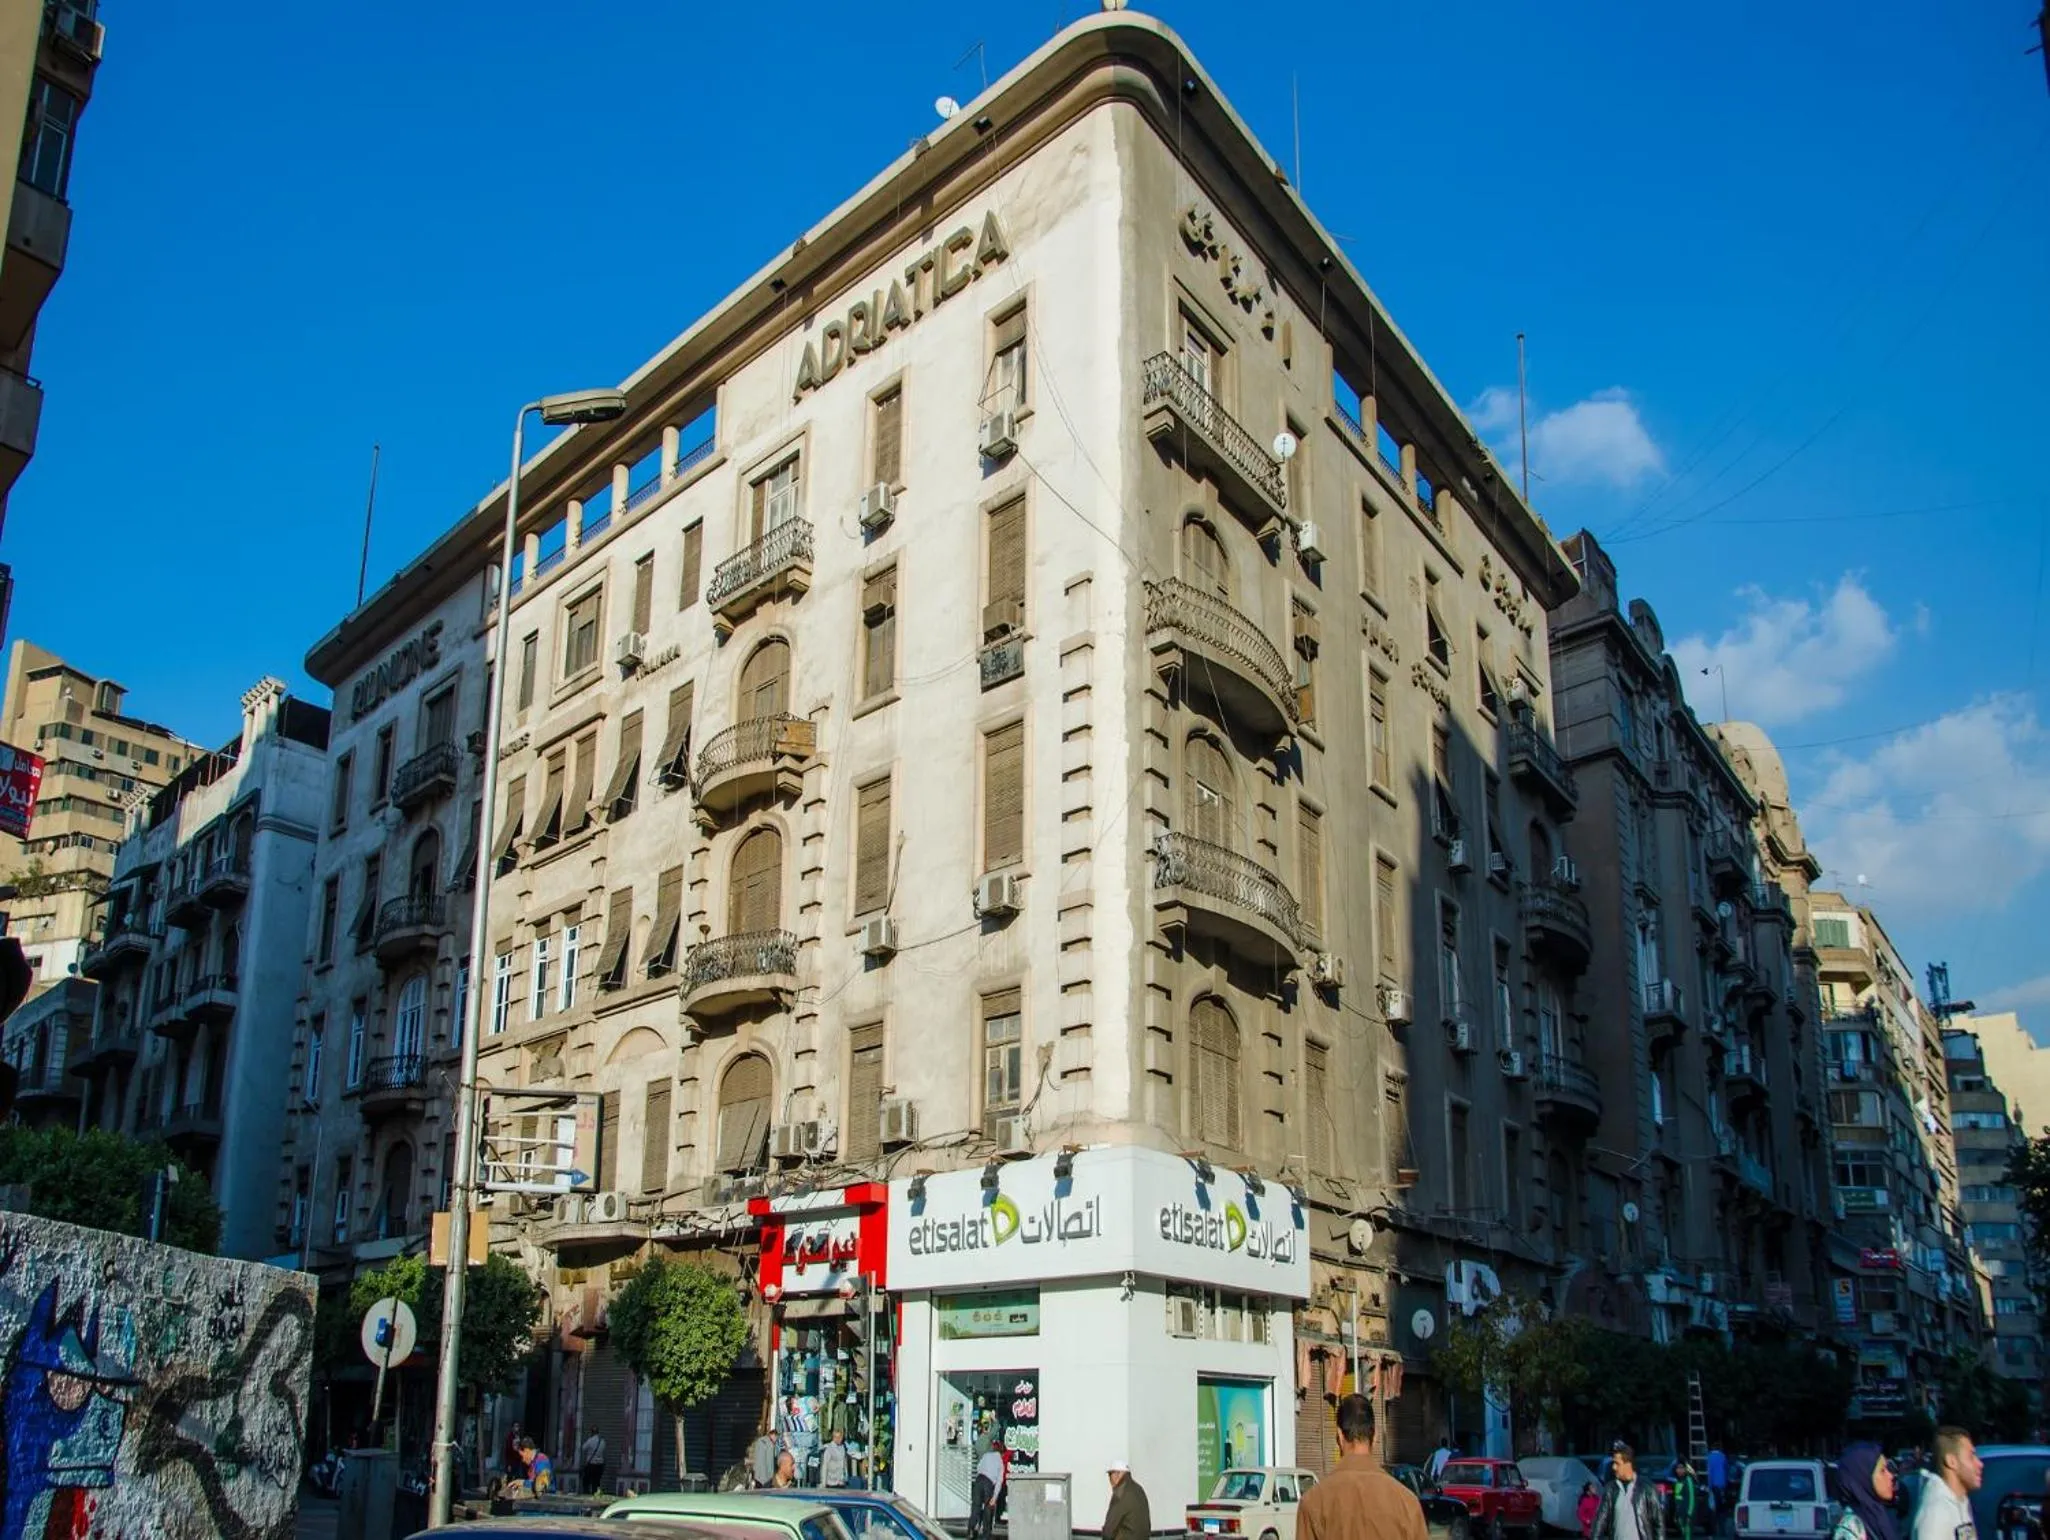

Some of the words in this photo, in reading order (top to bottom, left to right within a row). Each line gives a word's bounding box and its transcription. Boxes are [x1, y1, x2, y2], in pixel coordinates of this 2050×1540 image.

[793, 209, 1008, 406] ADRIATICA
[908, 1211, 989, 1255] etisalat
[1020, 1195, 1102, 1247] اتصالات
[1159, 1202, 1226, 1250] etisalat
[1246, 1221, 1296, 1267] اتصالات
